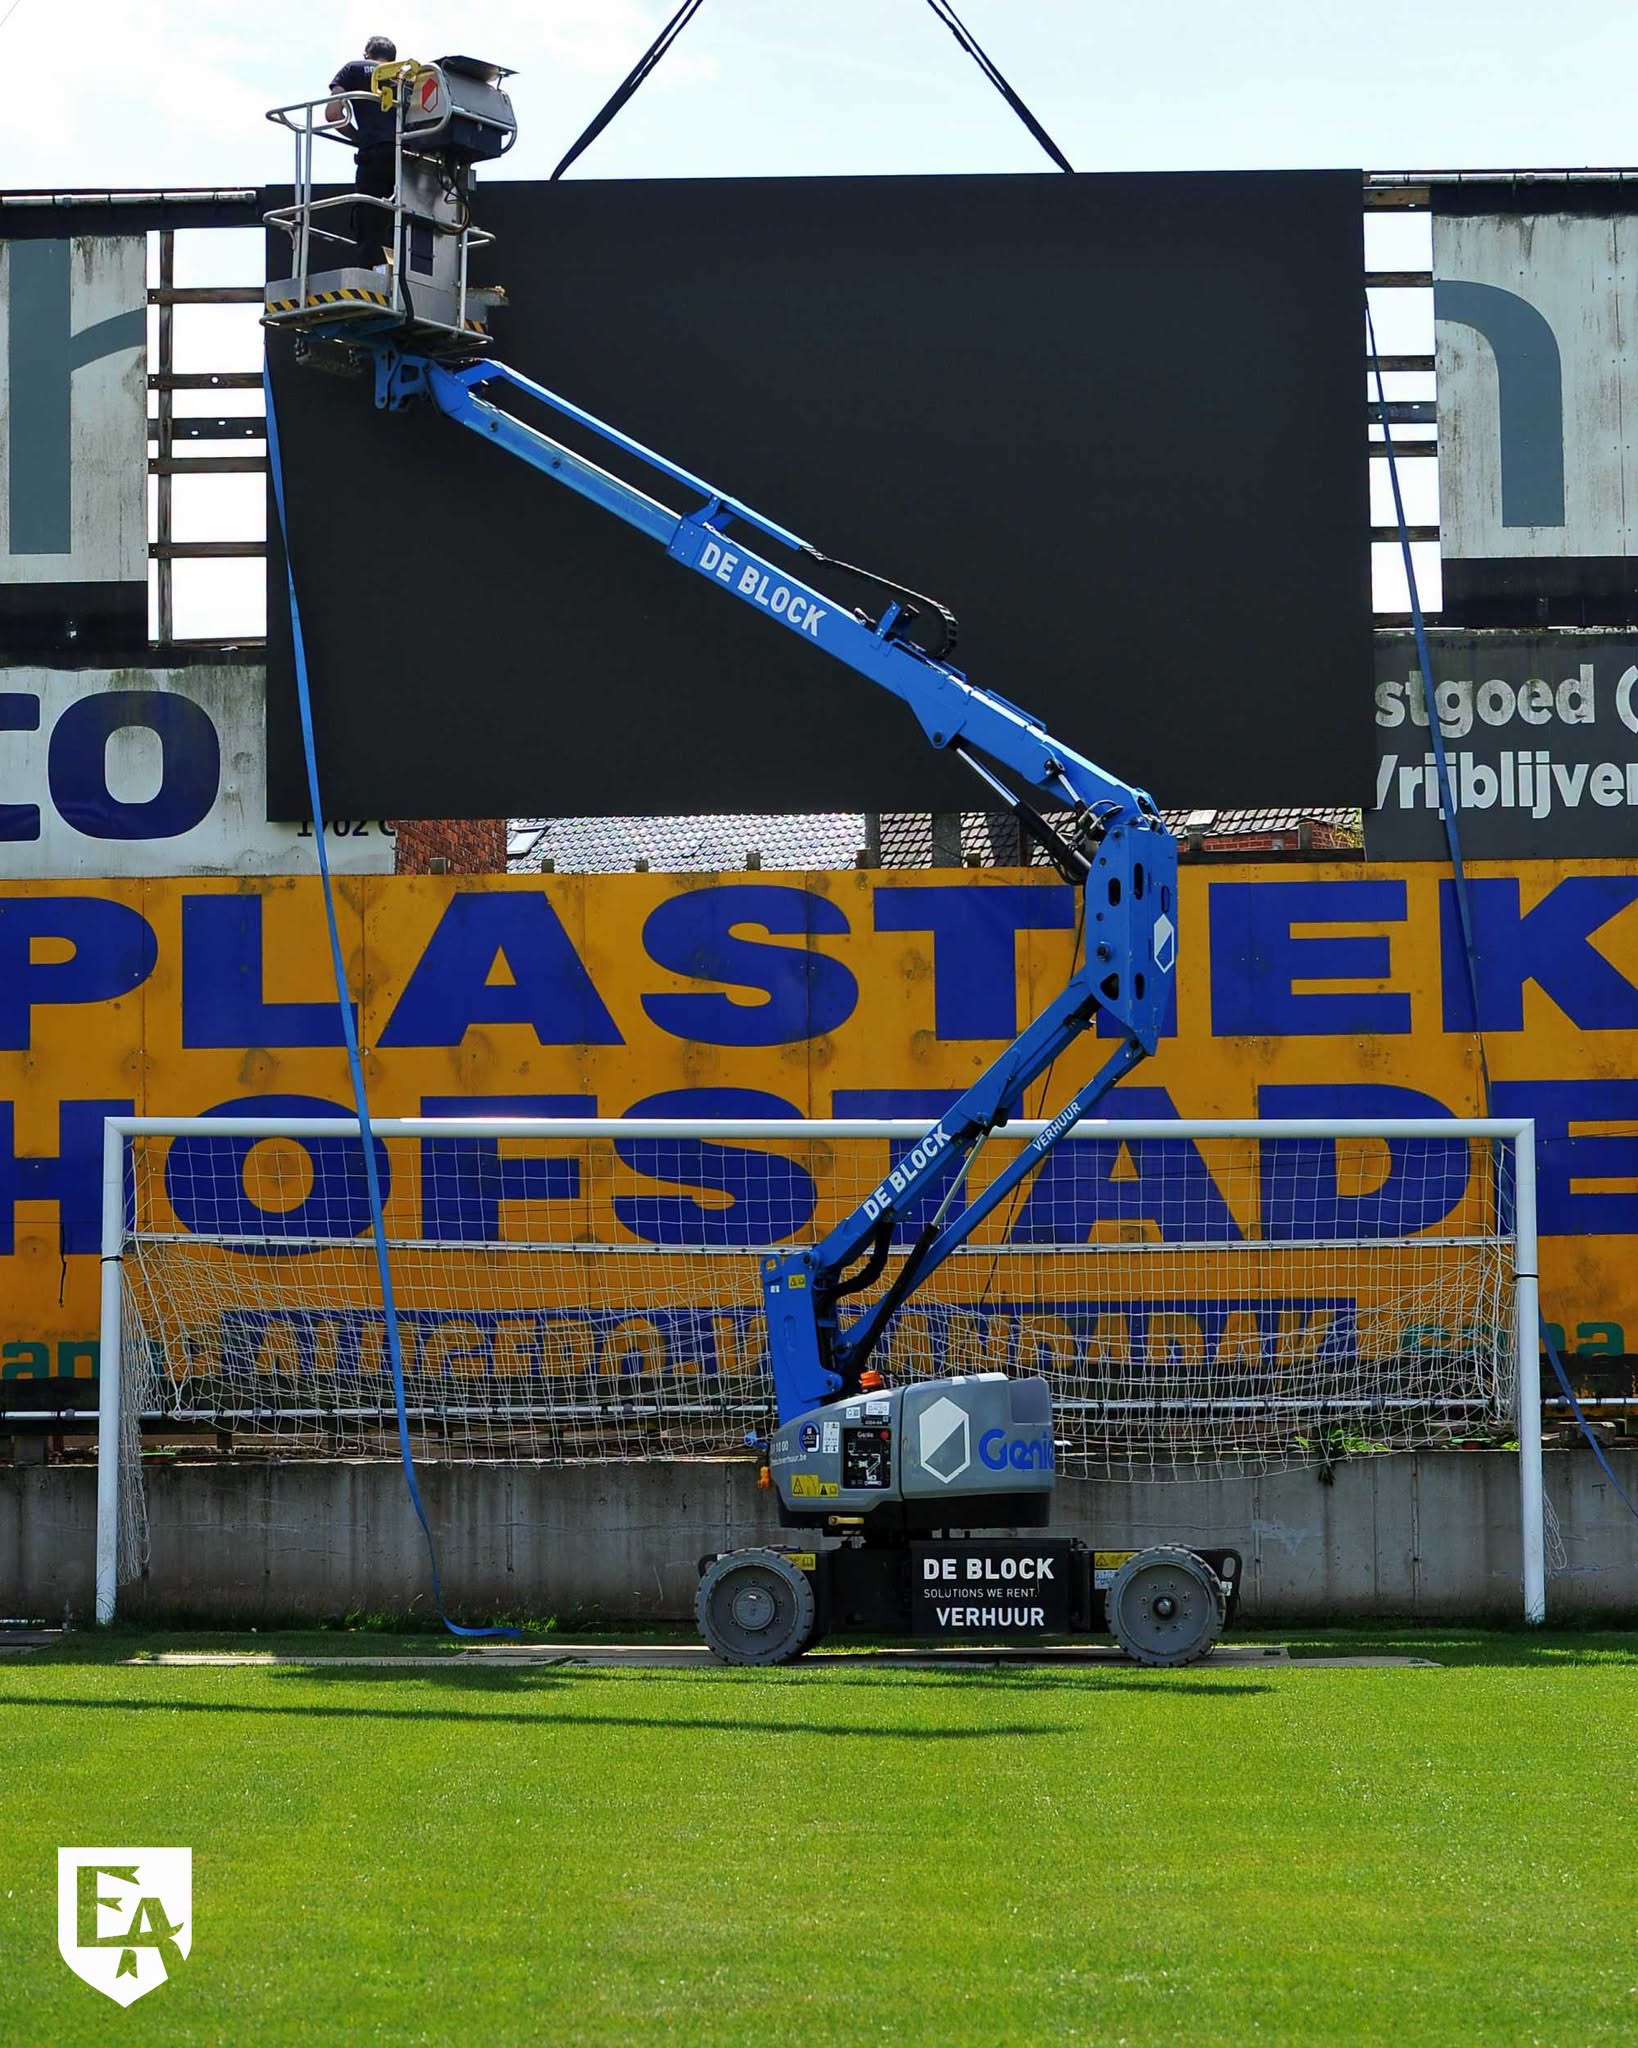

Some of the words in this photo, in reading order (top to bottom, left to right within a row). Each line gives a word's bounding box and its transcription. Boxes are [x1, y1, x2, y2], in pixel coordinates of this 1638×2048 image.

[699, 541, 739, 583] DE
[737, 565, 827, 637] BLOCK
[1374, 664, 1596, 739] stgoed
[1373, 750, 1638, 820] rijblijve
[297, 820, 369, 837] 102
[0, 876, 1638, 1051] PLASTEK
[1032, 1101, 1082, 1152] VERHUUR
[862, 1186, 892, 1221] DE
[888, 1122, 953, 1193] BLOCK
[923, 1558, 957, 1580] DE
[966, 1558, 1055, 1580] BLOCK
[924, 1588, 984, 1599] SOLUTIONS
[986, 1588, 1003, 1598] WE
[1006, 1588, 1038, 1598] RENT.
[936, 1607, 1045, 1626] VERHUUR
